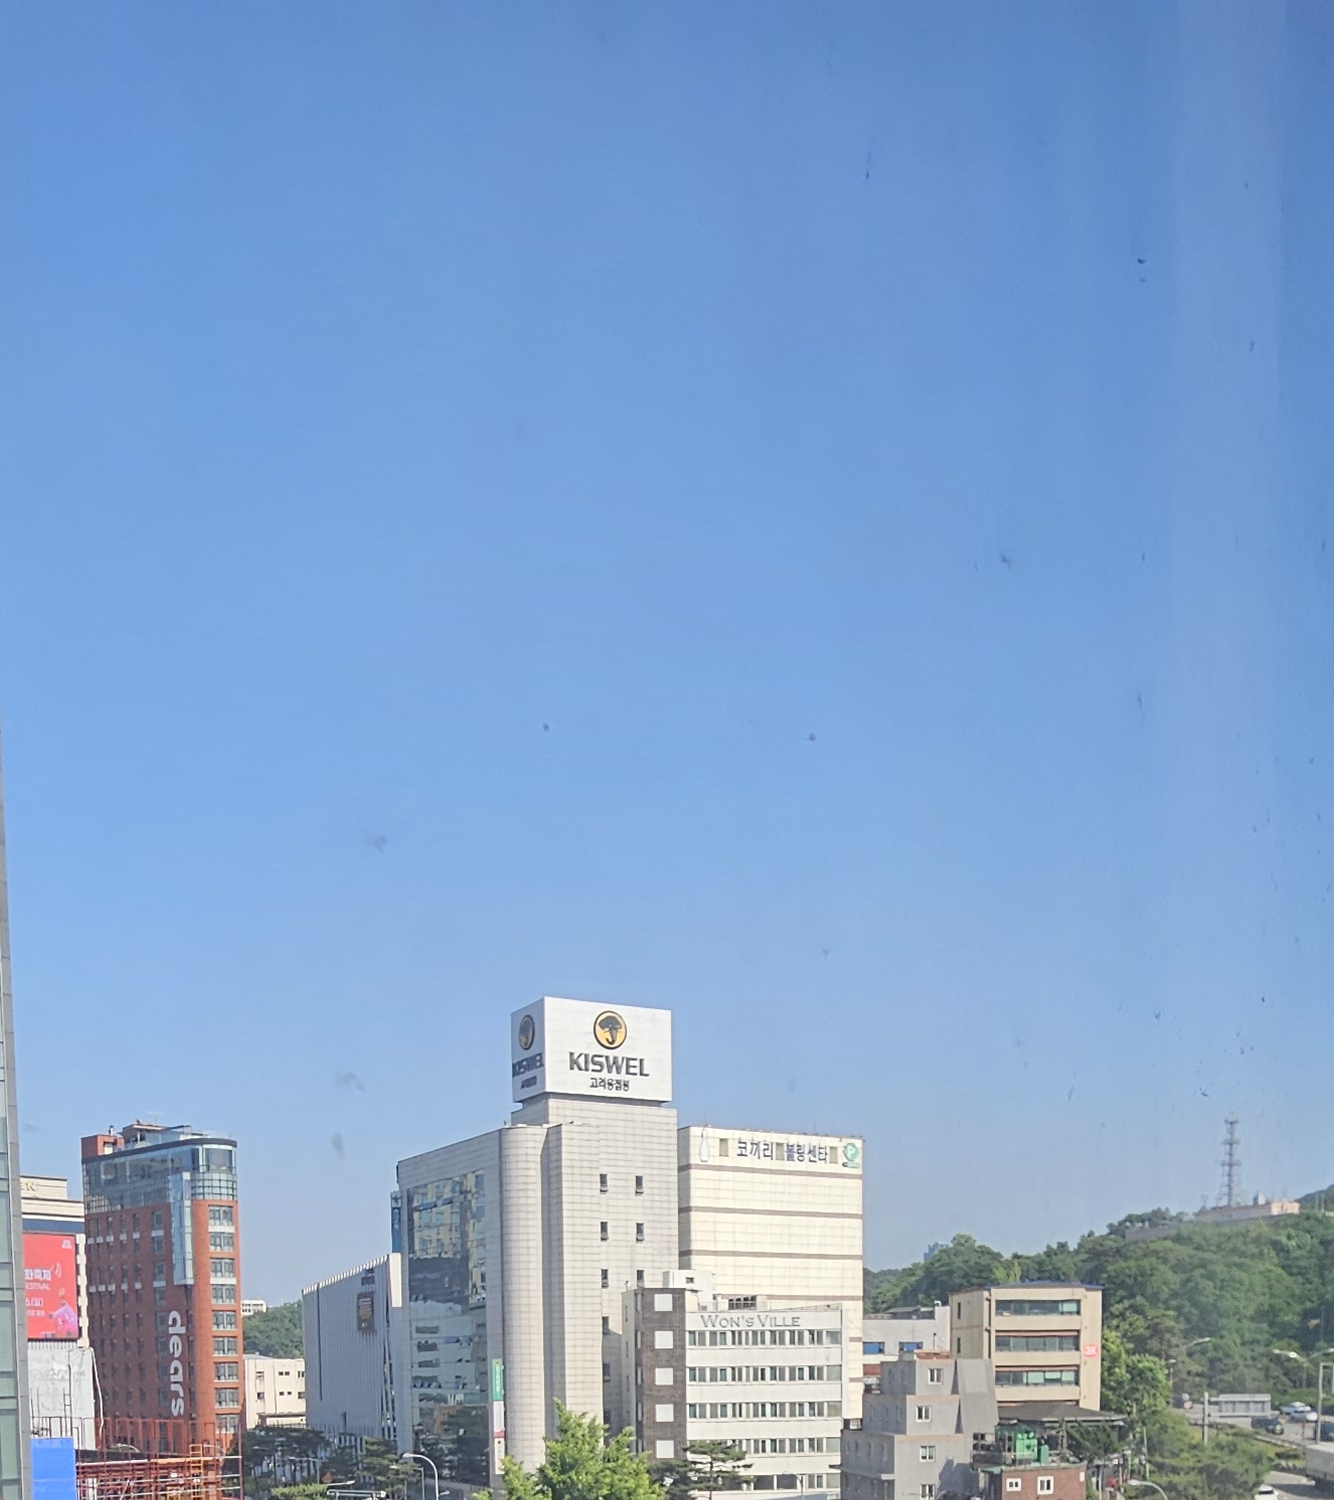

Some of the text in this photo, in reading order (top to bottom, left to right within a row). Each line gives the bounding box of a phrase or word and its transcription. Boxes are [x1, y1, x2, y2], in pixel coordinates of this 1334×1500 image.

[569, 1051, 650, 1077] KISWEL
[737, 1139, 774, 1160] 코끼리
[167, 1309, 186, 1417] dears
